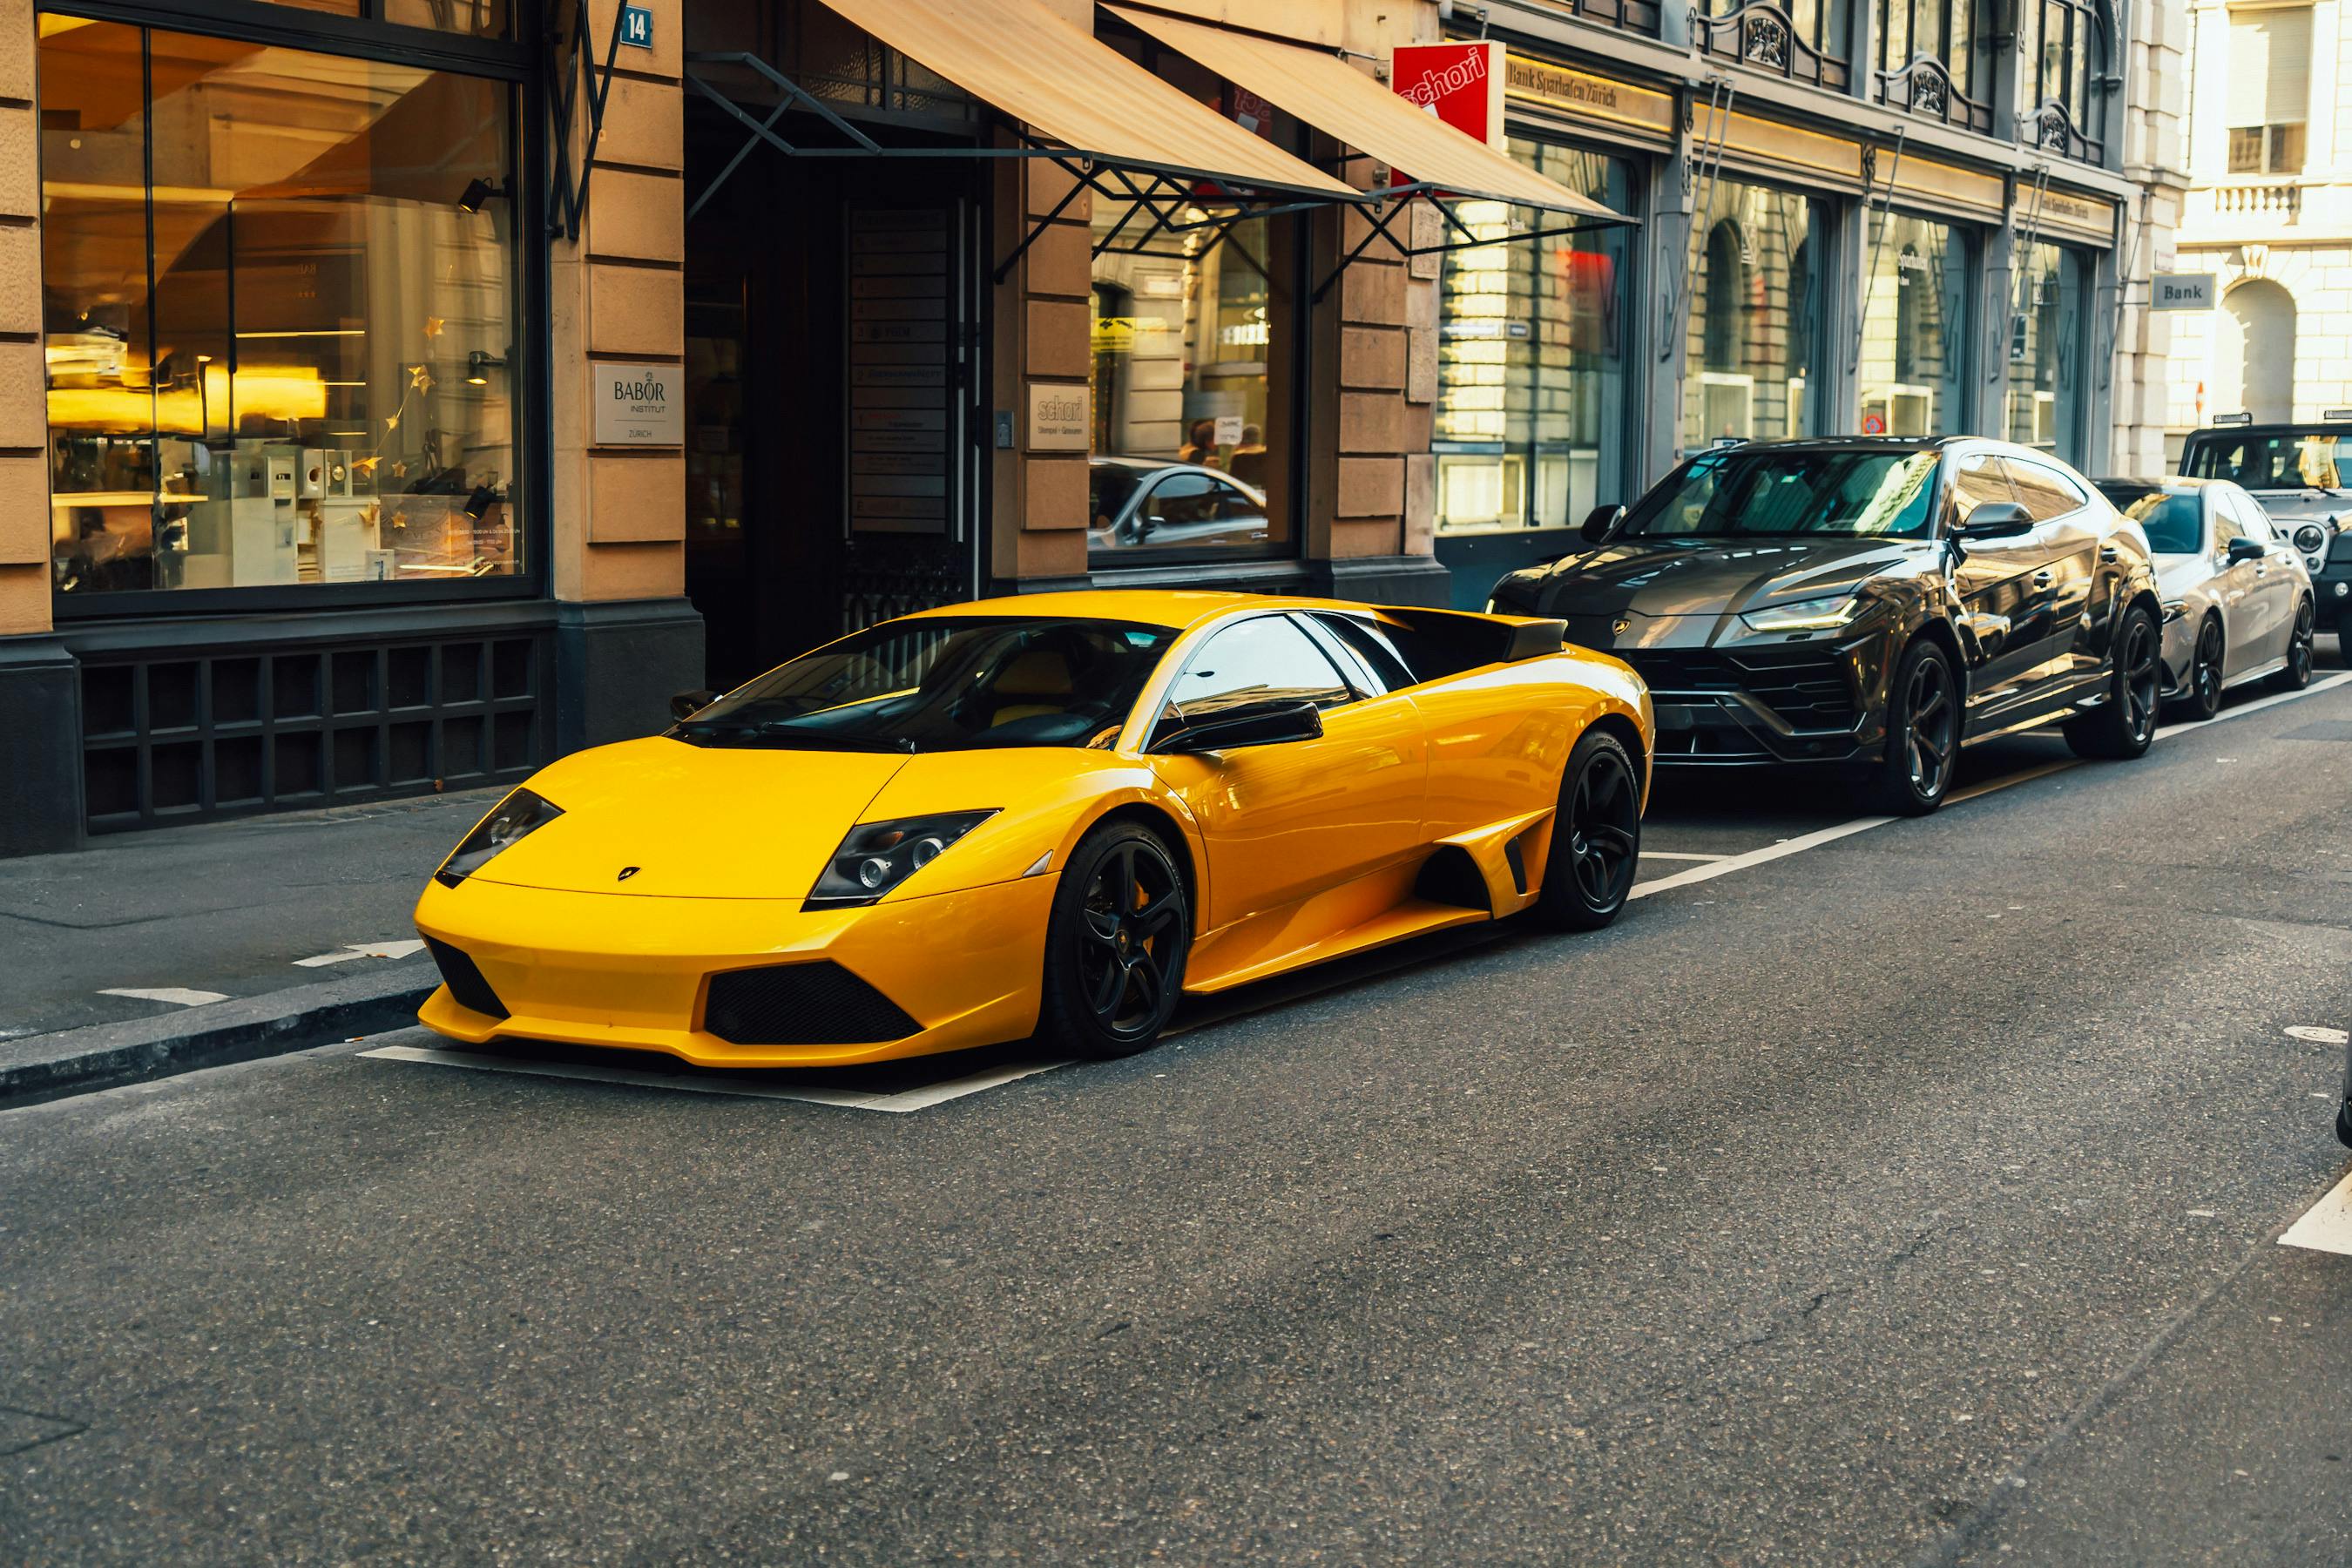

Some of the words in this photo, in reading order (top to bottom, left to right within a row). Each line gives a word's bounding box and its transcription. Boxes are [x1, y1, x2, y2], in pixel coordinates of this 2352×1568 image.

[628, 12, 646, 41] 14
[1509, 63, 1535, 89] Bank
[1537, 71, 1585, 100] Sparhafen
[1586, 83, 1617, 108] Zürich
[2164, 284, 2202, 300] Bank
[614, 381, 666, 402] BABOR
[631, 405, 666, 414] INSTITUT
[1037, 395, 1083, 422] schori
